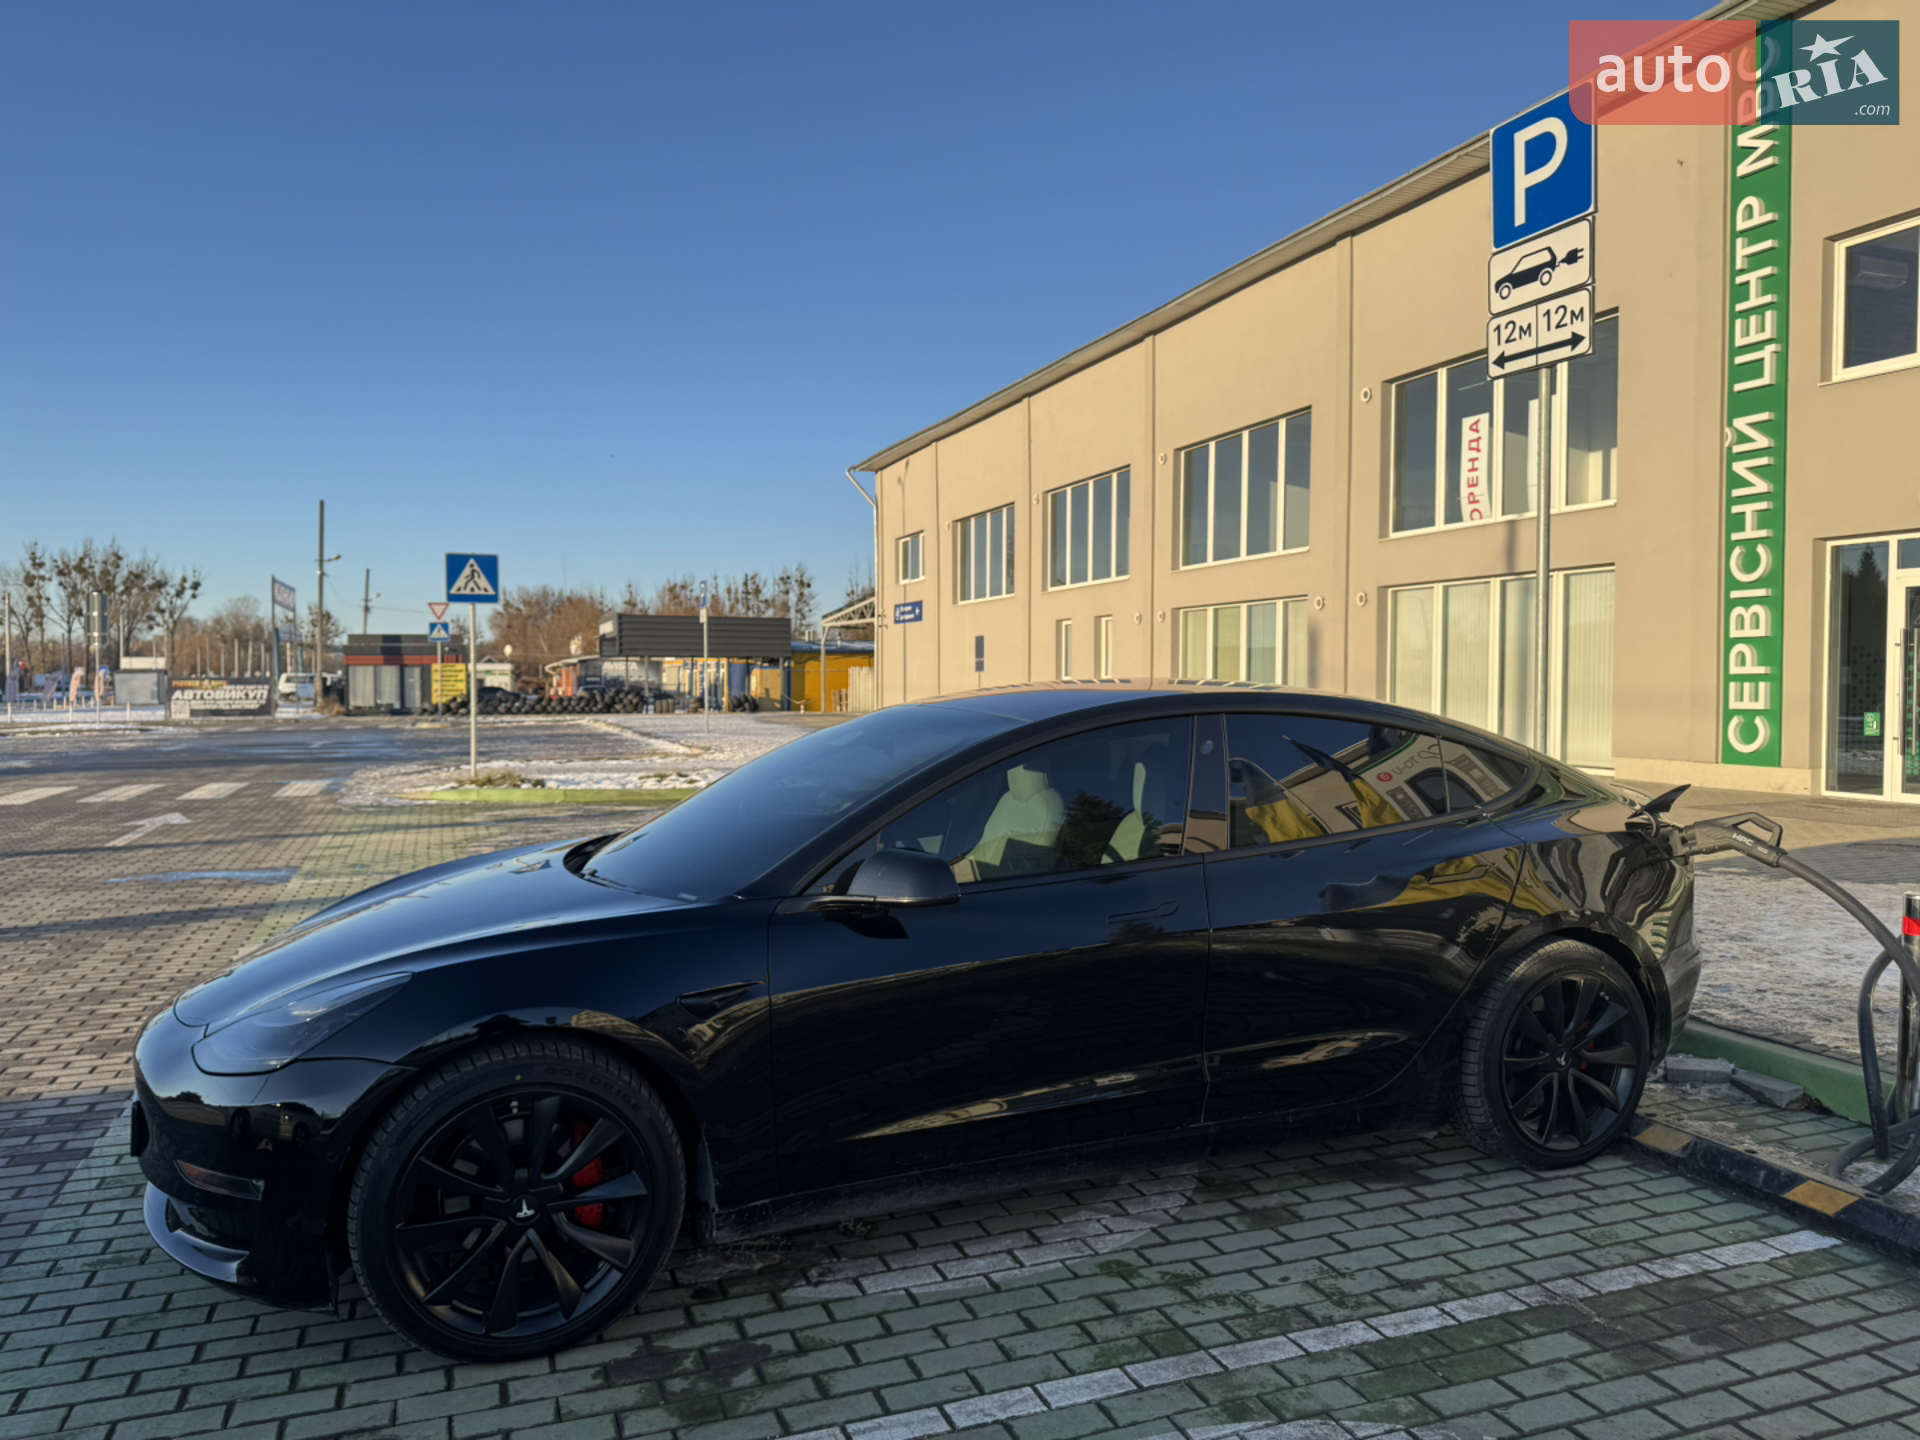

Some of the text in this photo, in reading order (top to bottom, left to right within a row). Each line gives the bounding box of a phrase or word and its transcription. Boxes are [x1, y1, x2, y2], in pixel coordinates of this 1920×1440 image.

[1514, 117, 1568, 227] P
[1725, 36, 1781, 753] СЕРВІСНИЙ ЦЕНТР МВС
[1467, 418, 1483, 521] ОРЕНДА
[171, 689, 269, 700] АВТОВИКУП
[1731, 832, 1754, 847] HPC
[543, 1065, 643, 1114] GOODRIDE
